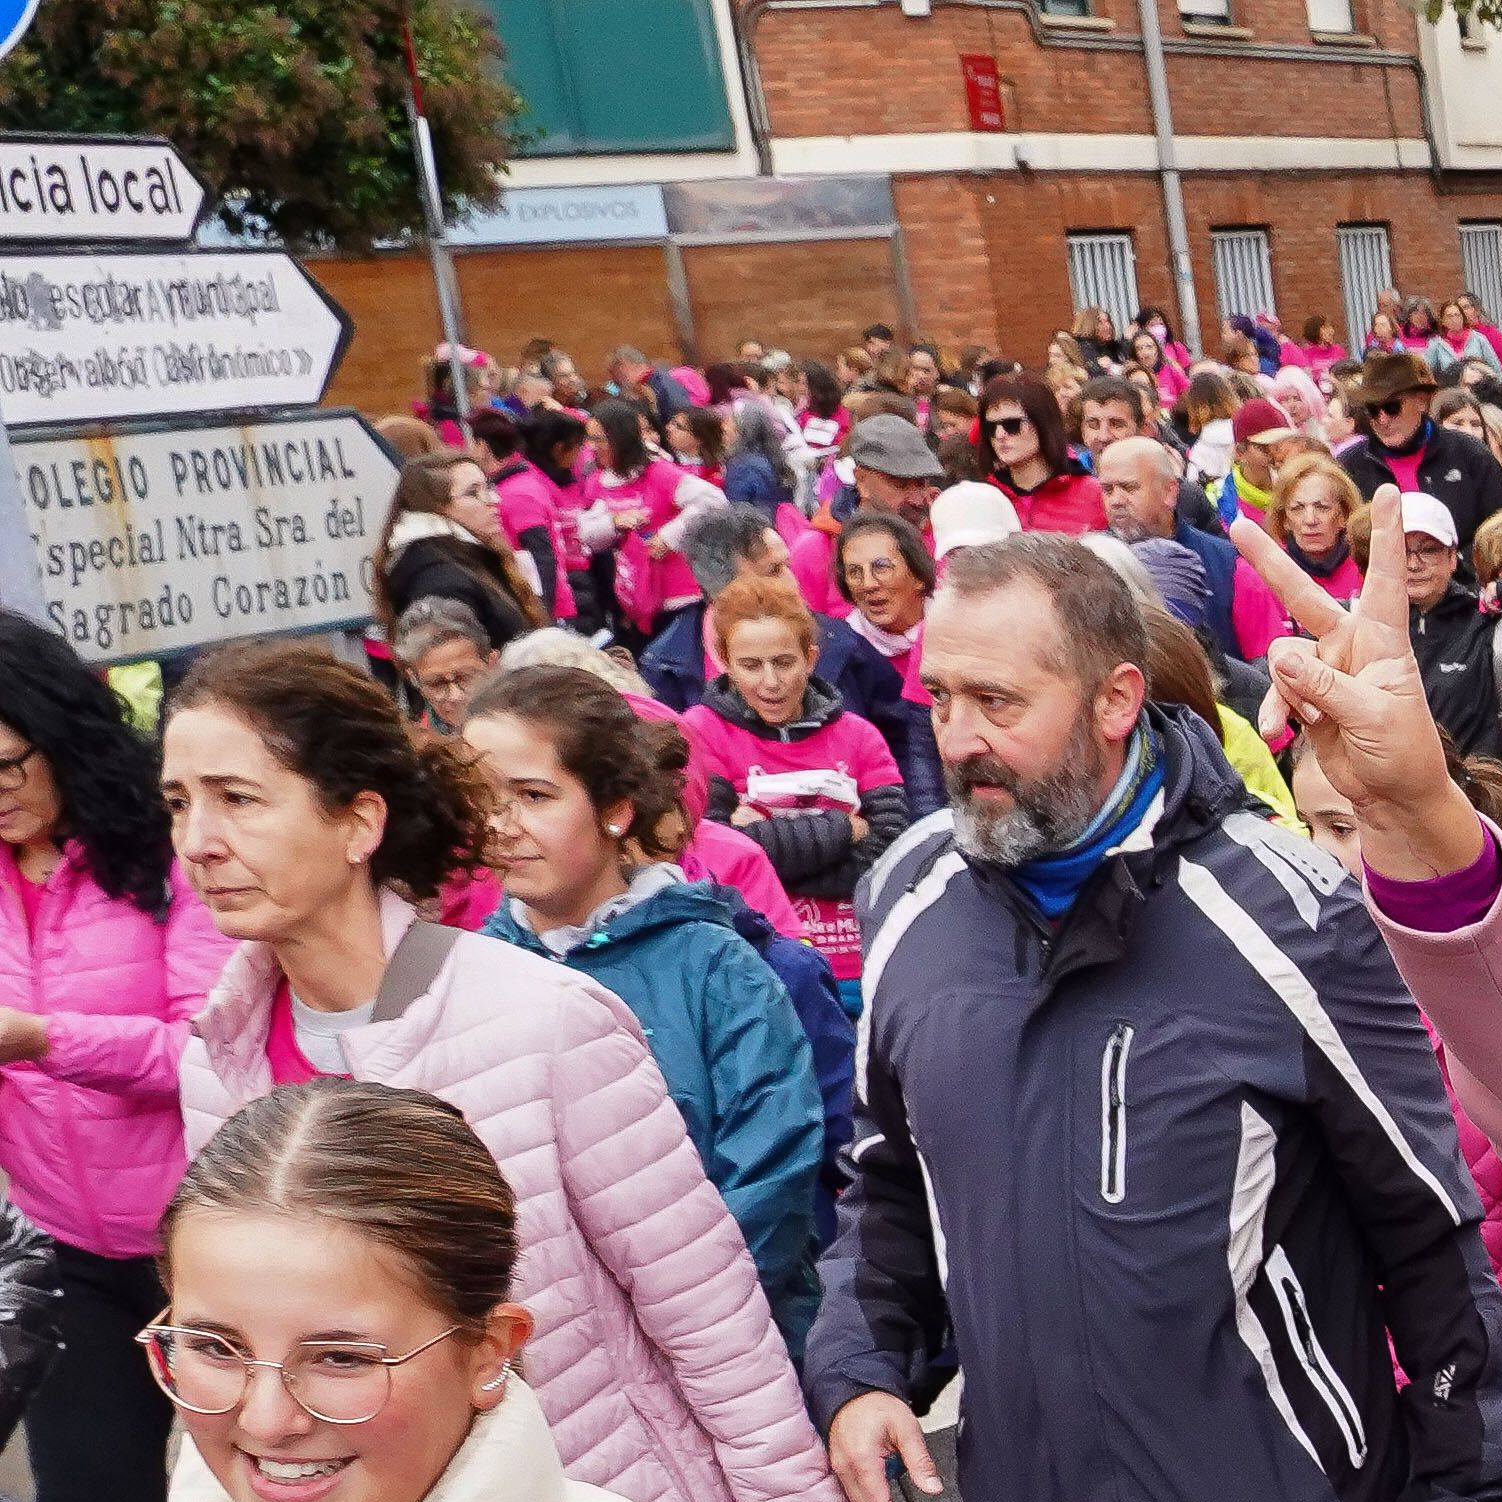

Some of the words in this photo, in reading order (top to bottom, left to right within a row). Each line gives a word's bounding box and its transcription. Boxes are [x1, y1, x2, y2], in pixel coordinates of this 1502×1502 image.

[80, 154, 183, 215] local
[26, 452, 148, 511] OLEGIO
[168, 437, 356, 496] PROVINCIAL
[31, 518, 167, 587] special
[325, 496, 366, 540] del
[212, 560, 352, 619] Corazón
